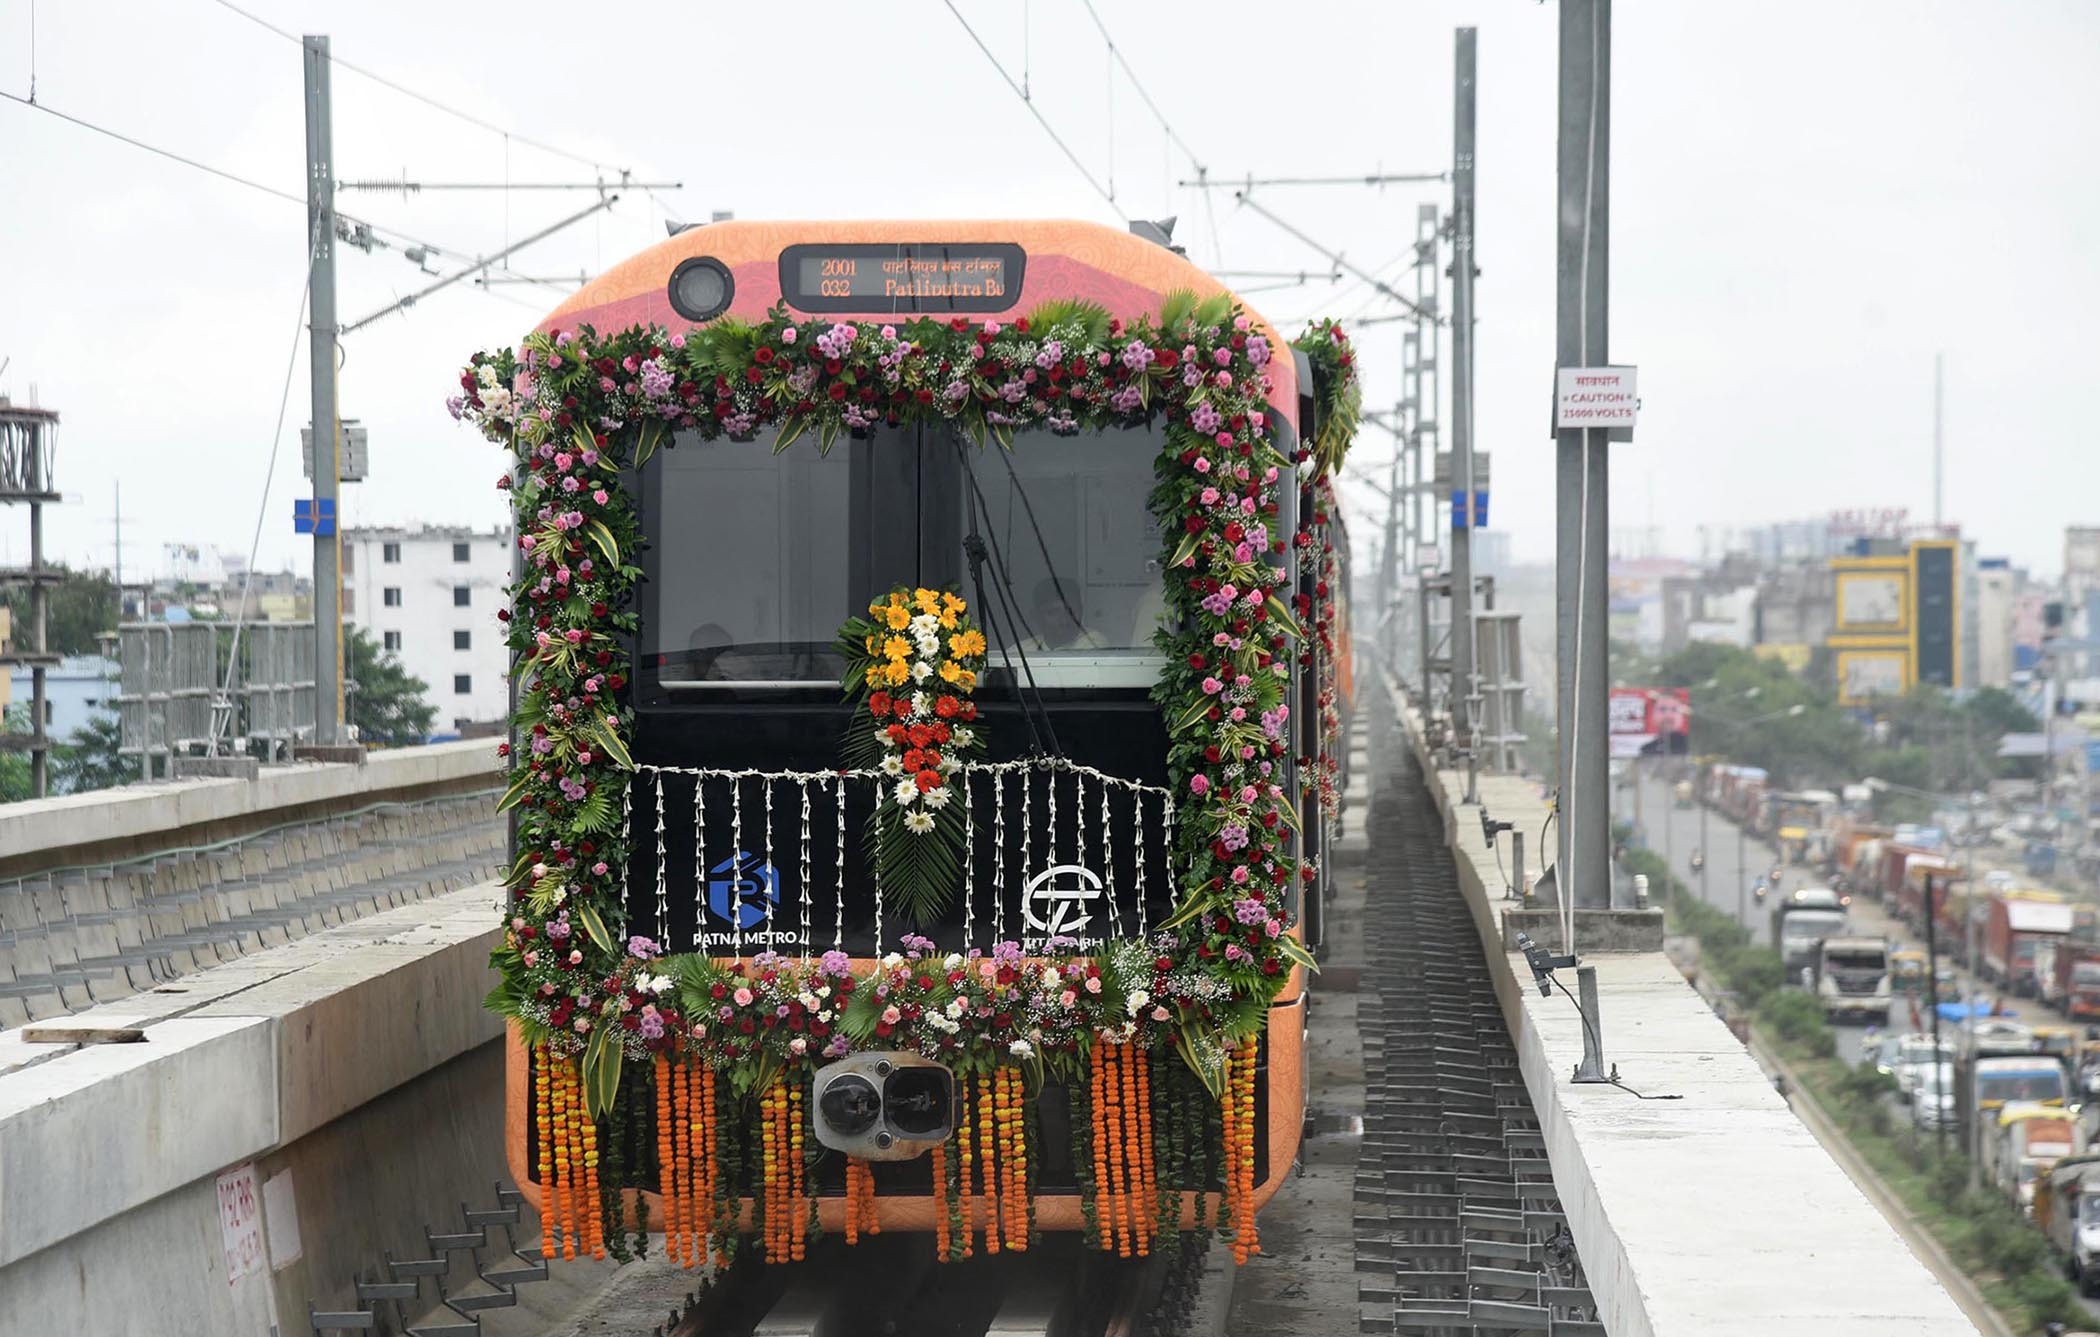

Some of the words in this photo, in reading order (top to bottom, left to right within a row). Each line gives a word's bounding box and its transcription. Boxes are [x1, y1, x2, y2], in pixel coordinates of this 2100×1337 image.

[821, 258, 857, 276] 2001
[821, 279, 850, 297] 032
[1571, 393, 1624, 403] CAUTION
[1596, 408, 1632, 417] VOLTS
[744, 931, 797, 945] METRO
